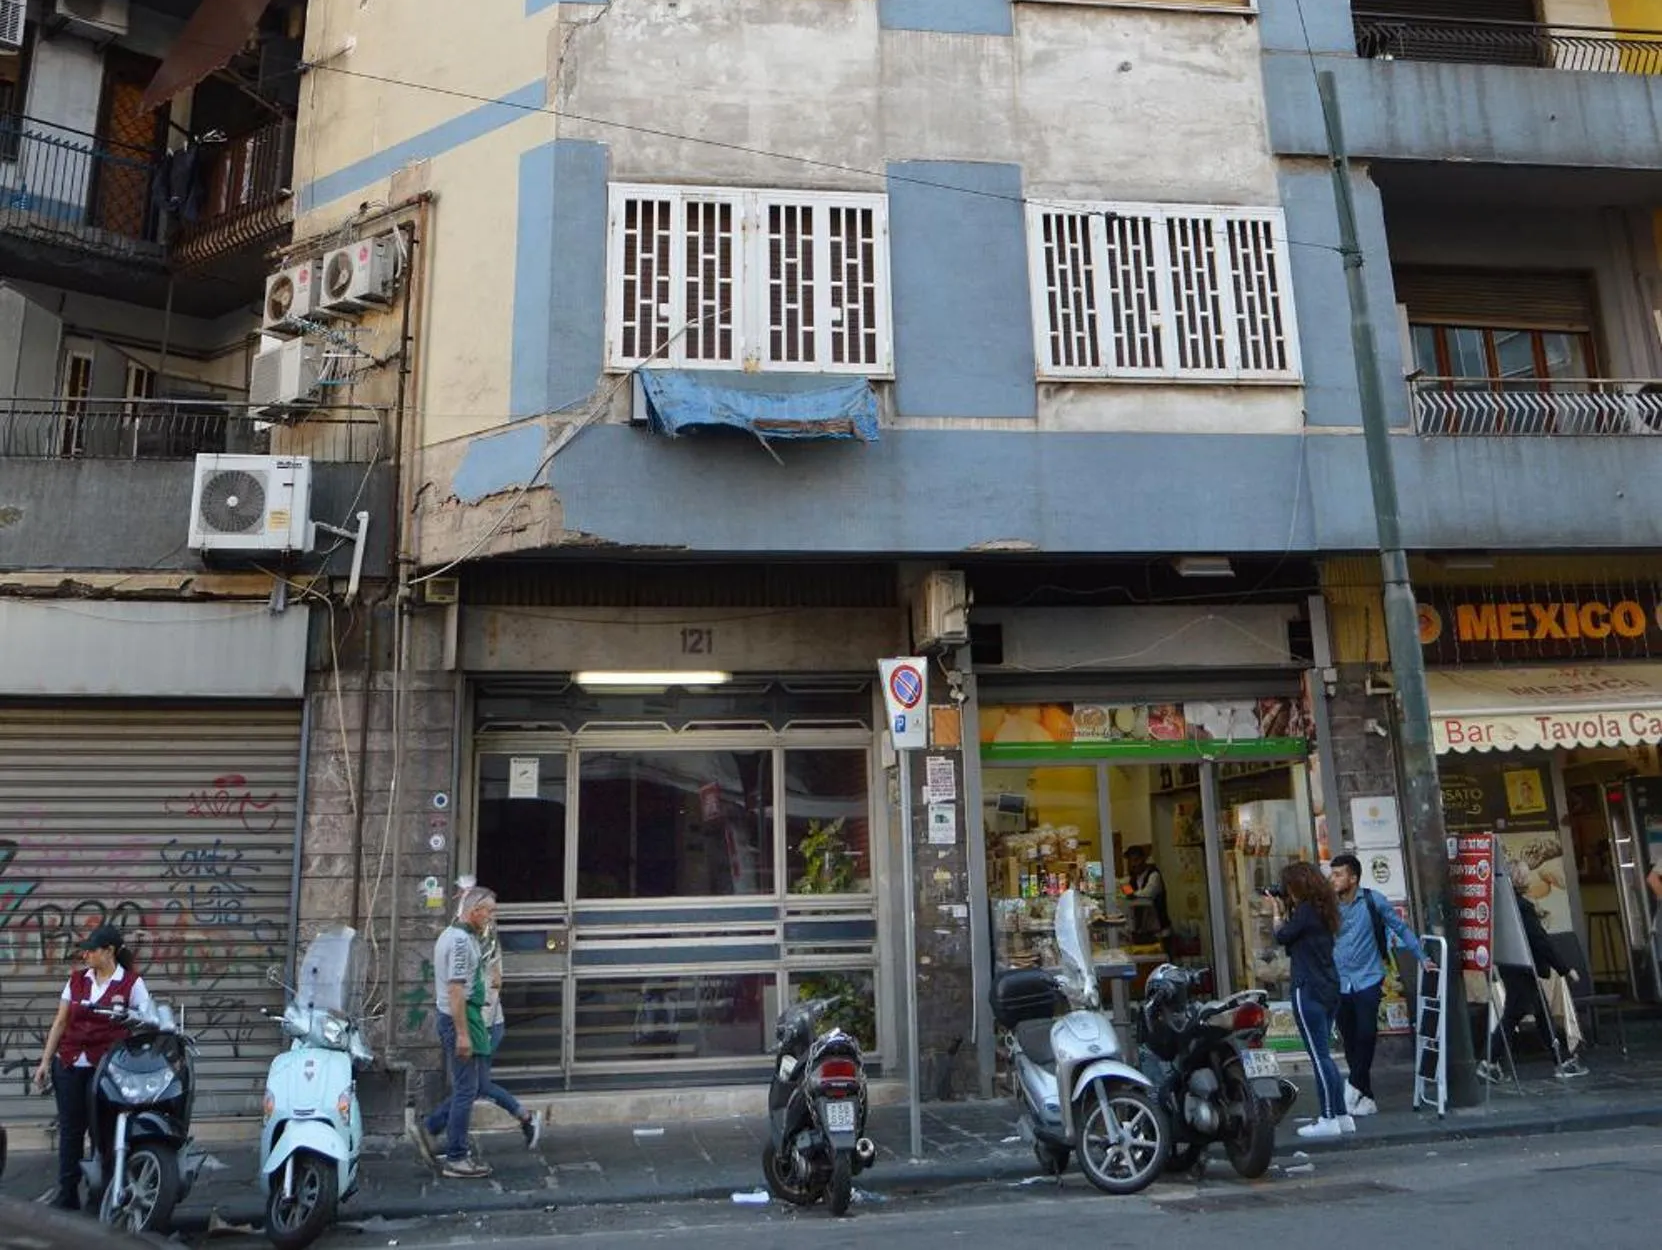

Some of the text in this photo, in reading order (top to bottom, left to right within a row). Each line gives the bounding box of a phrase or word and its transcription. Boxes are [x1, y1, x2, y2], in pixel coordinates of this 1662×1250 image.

[1457, 602, 1646, 641] MEXICO
[680, 627, 712, 654] 121
[1445, 720, 1494, 744] Bar
[1536, 714, 1621, 740] Tavola
